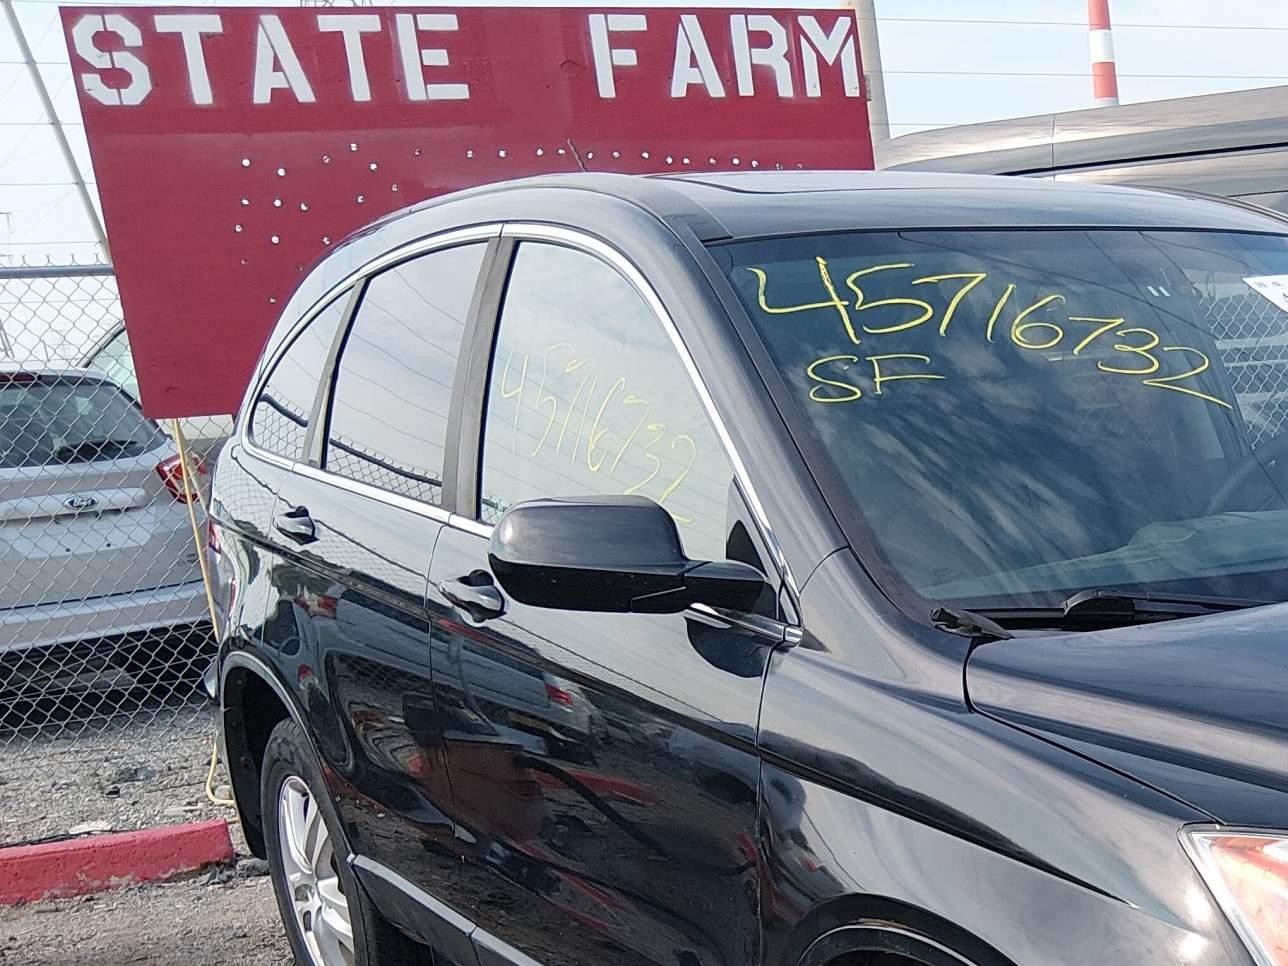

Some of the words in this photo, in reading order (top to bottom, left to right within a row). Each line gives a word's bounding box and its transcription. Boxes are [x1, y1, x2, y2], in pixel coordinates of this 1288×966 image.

[72, 14, 470, 107] STATE
[588, 13, 861, 99] FARM
[747, 256, 1233, 410] 45716732
[807, 354, 946, 404] SF
